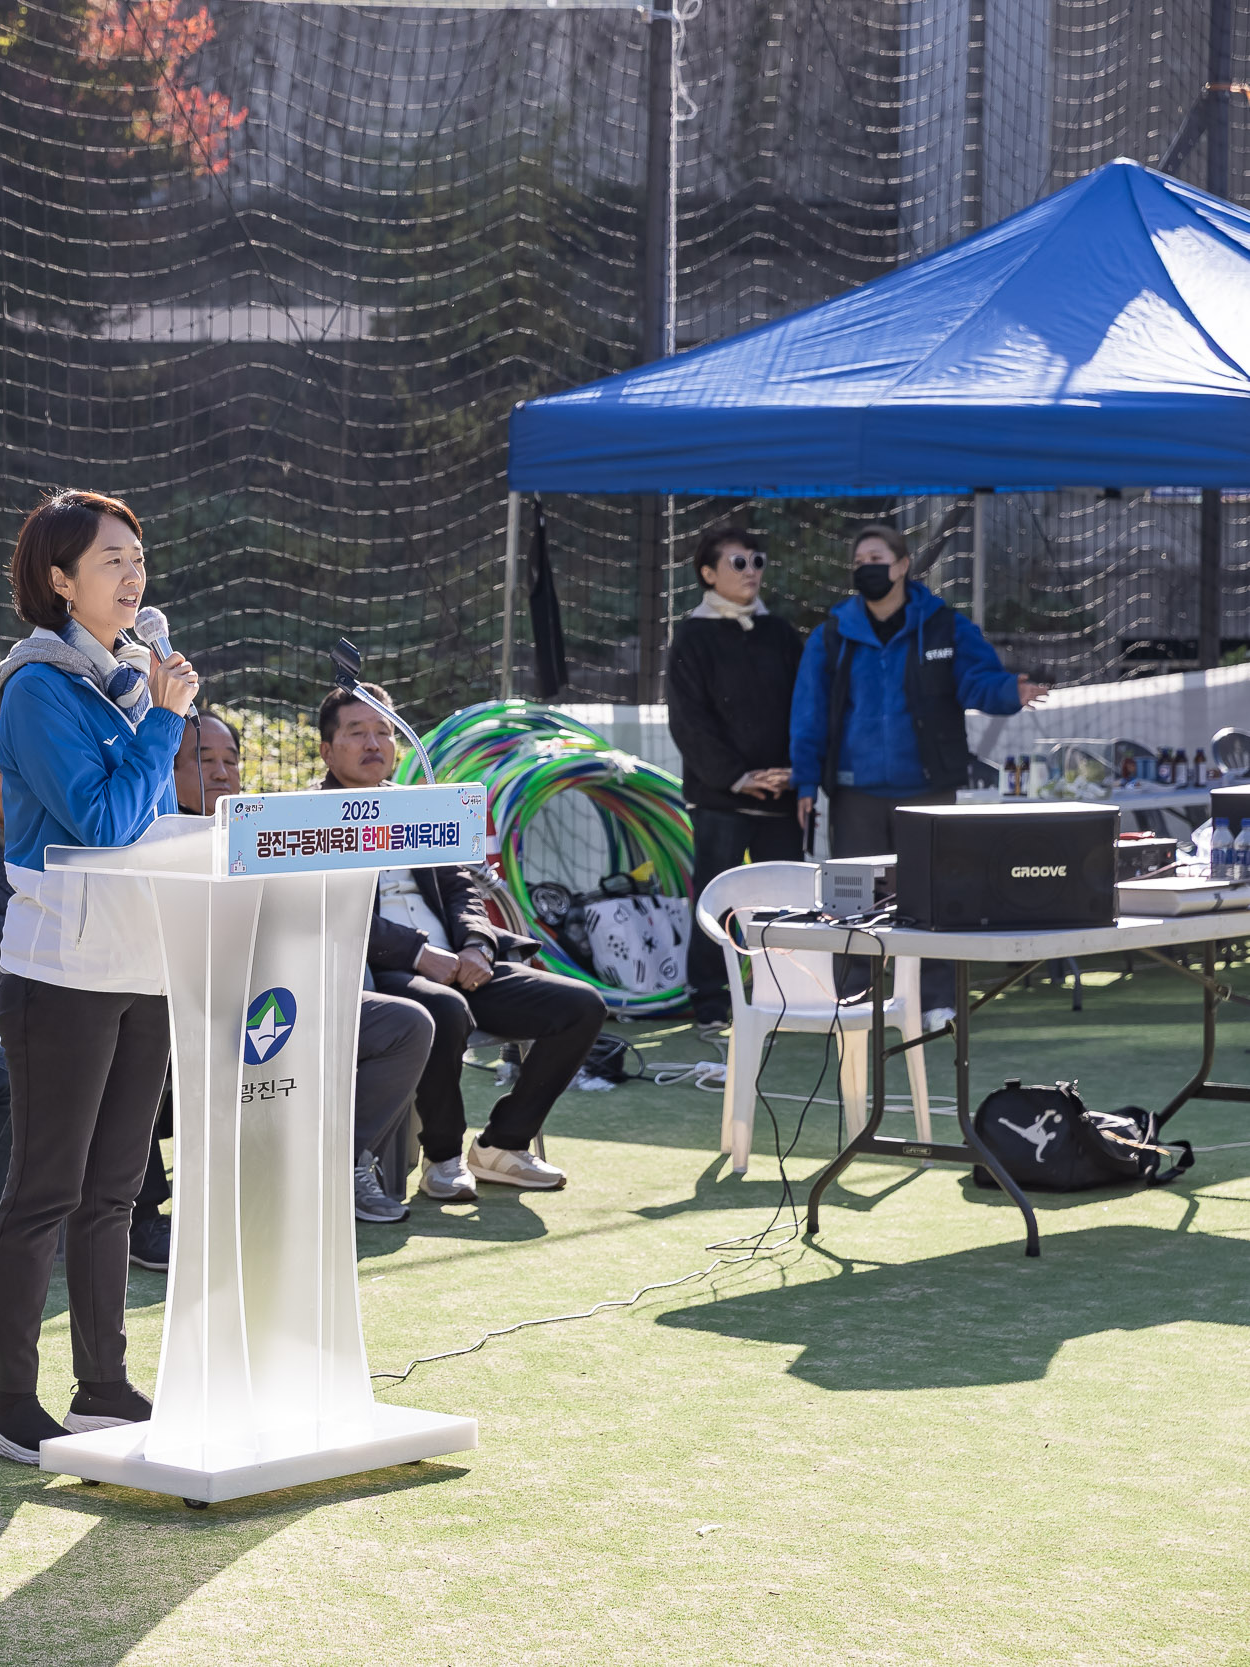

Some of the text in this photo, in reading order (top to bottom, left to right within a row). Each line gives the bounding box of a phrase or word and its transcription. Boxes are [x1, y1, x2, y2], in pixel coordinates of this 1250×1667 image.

[244, 804, 264, 813] 광진구
[341, 800, 380, 821] 2025
[256, 821, 460, 858] 광진구동체육회 한마음체육대회
[1011, 865, 1067, 878] GROOVE
[241, 1078, 297, 1103] 광진구
